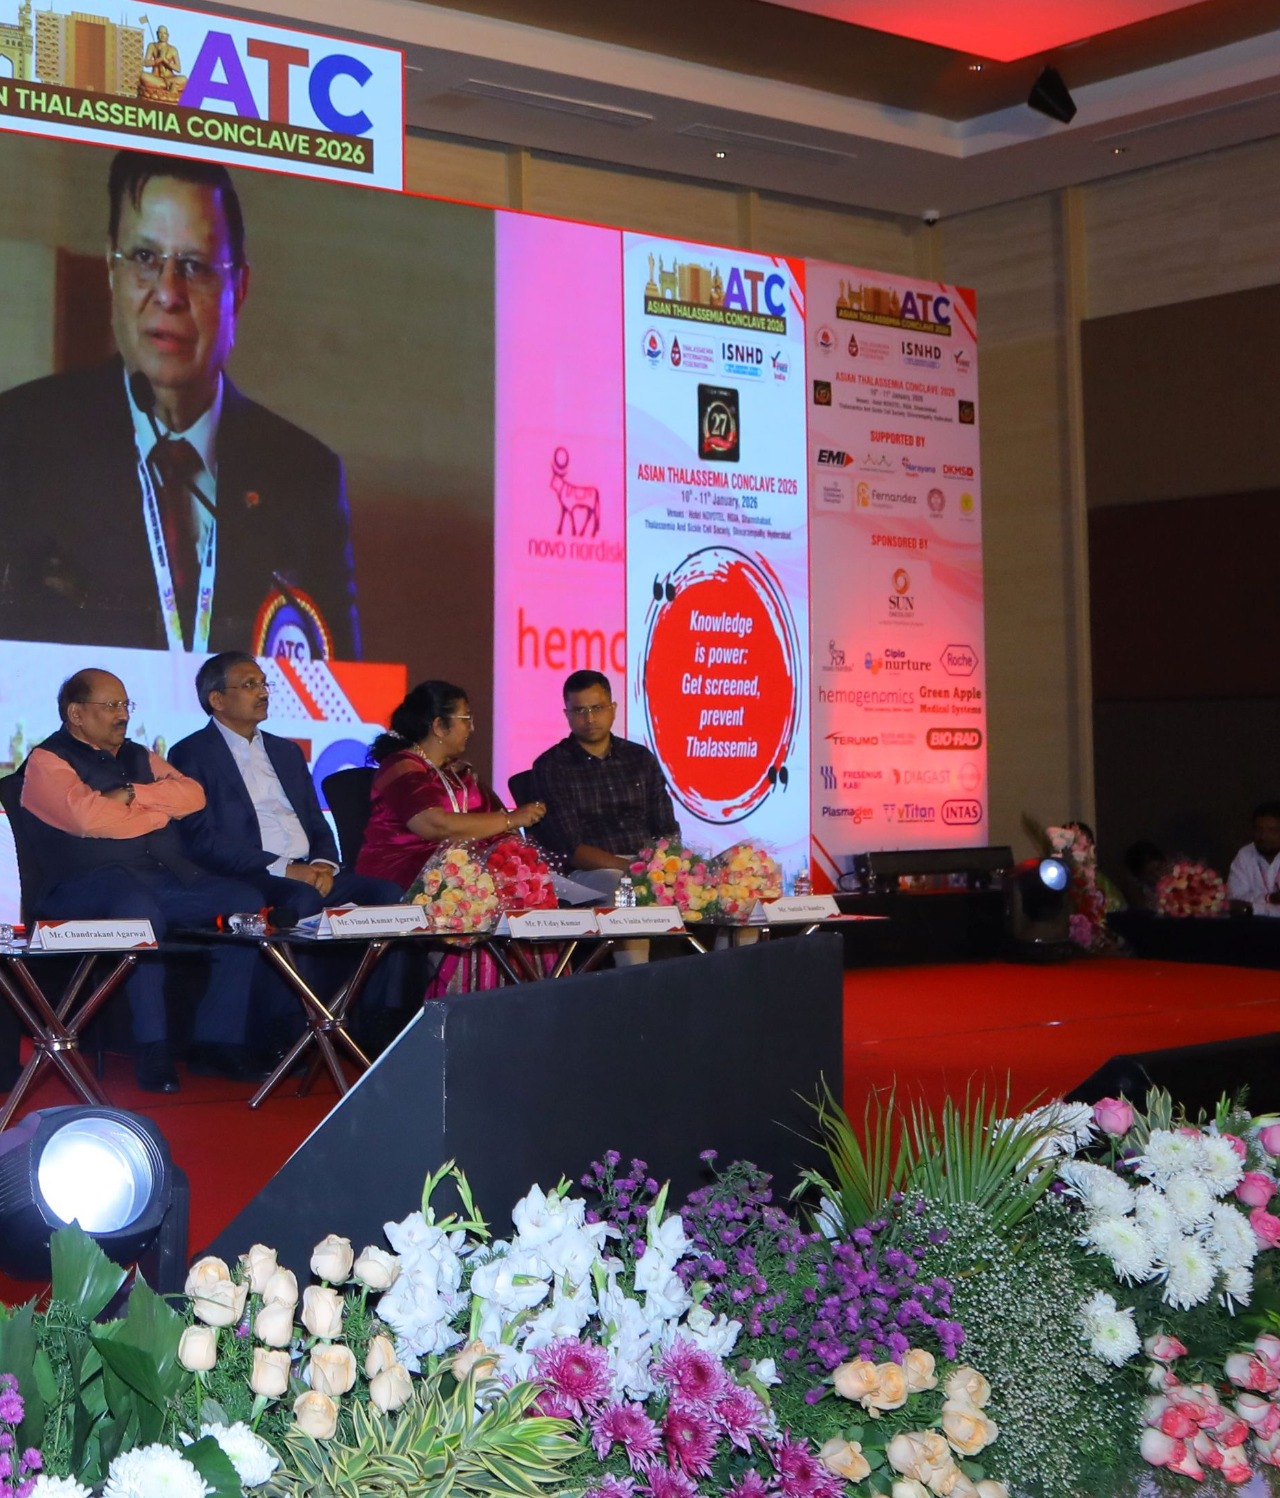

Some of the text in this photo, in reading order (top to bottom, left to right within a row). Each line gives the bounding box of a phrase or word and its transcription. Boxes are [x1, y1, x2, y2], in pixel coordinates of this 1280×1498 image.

[177, 30, 373, 137] ATC
[15, 87, 181, 135] THALASSEMIA
[186, 115, 310, 157] CONCLAVE
[315, 136, 366, 166] 2026
[722, 266, 786, 316] ATC
[900, 290, 951, 324] ATC
[647, 301, 785, 333] ASIAN THALASSEMIA CONCLAVE 2026
[721, 342, 763, 365] ISNHD
[901, 341, 942, 360] ISNHD
[870, 430, 926, 447] SUPPORTED BY
[818, 449, 846, 465] EMI
[905, 462, 936, 475] Narayana
[637, 463, 798, 495] ASIAN THALASSEMIA CONCLAVE 2026
[871, 534, 928, 549] SPONSORED BY
[889, 596, 914, 611] SUN
[689, 609, 753, 637] Knowledge
[694, 642, 748, 666] is power:
[884, 648, 905, 659] Cipla
[947, 653, 973, 667] Roche
[885, 659, 931, 671] nurture
[681, 673, 760, 700] Get screened,
[919, 686, 982, 702] Green Apple
[818, 685, 914, 708] hemogenomics
[699, 706, 744, 730] prevent
[920, 704, 950, 714] Medical
[951, 704, 982, 716] Systems
[685, 735, 758, 758] Thalassemia
[904, 770, 951, 784] DIAGAST
[897, 803, 935, 818] vTitan
[946, 806, 978, 818] INTAS
[370, 917, 393, 925] Kumar
[394, 916, 420, 924] Agarwal
[48, 931, 64, 939] Mr.
[116, 930, 146, 939] Agarwal
